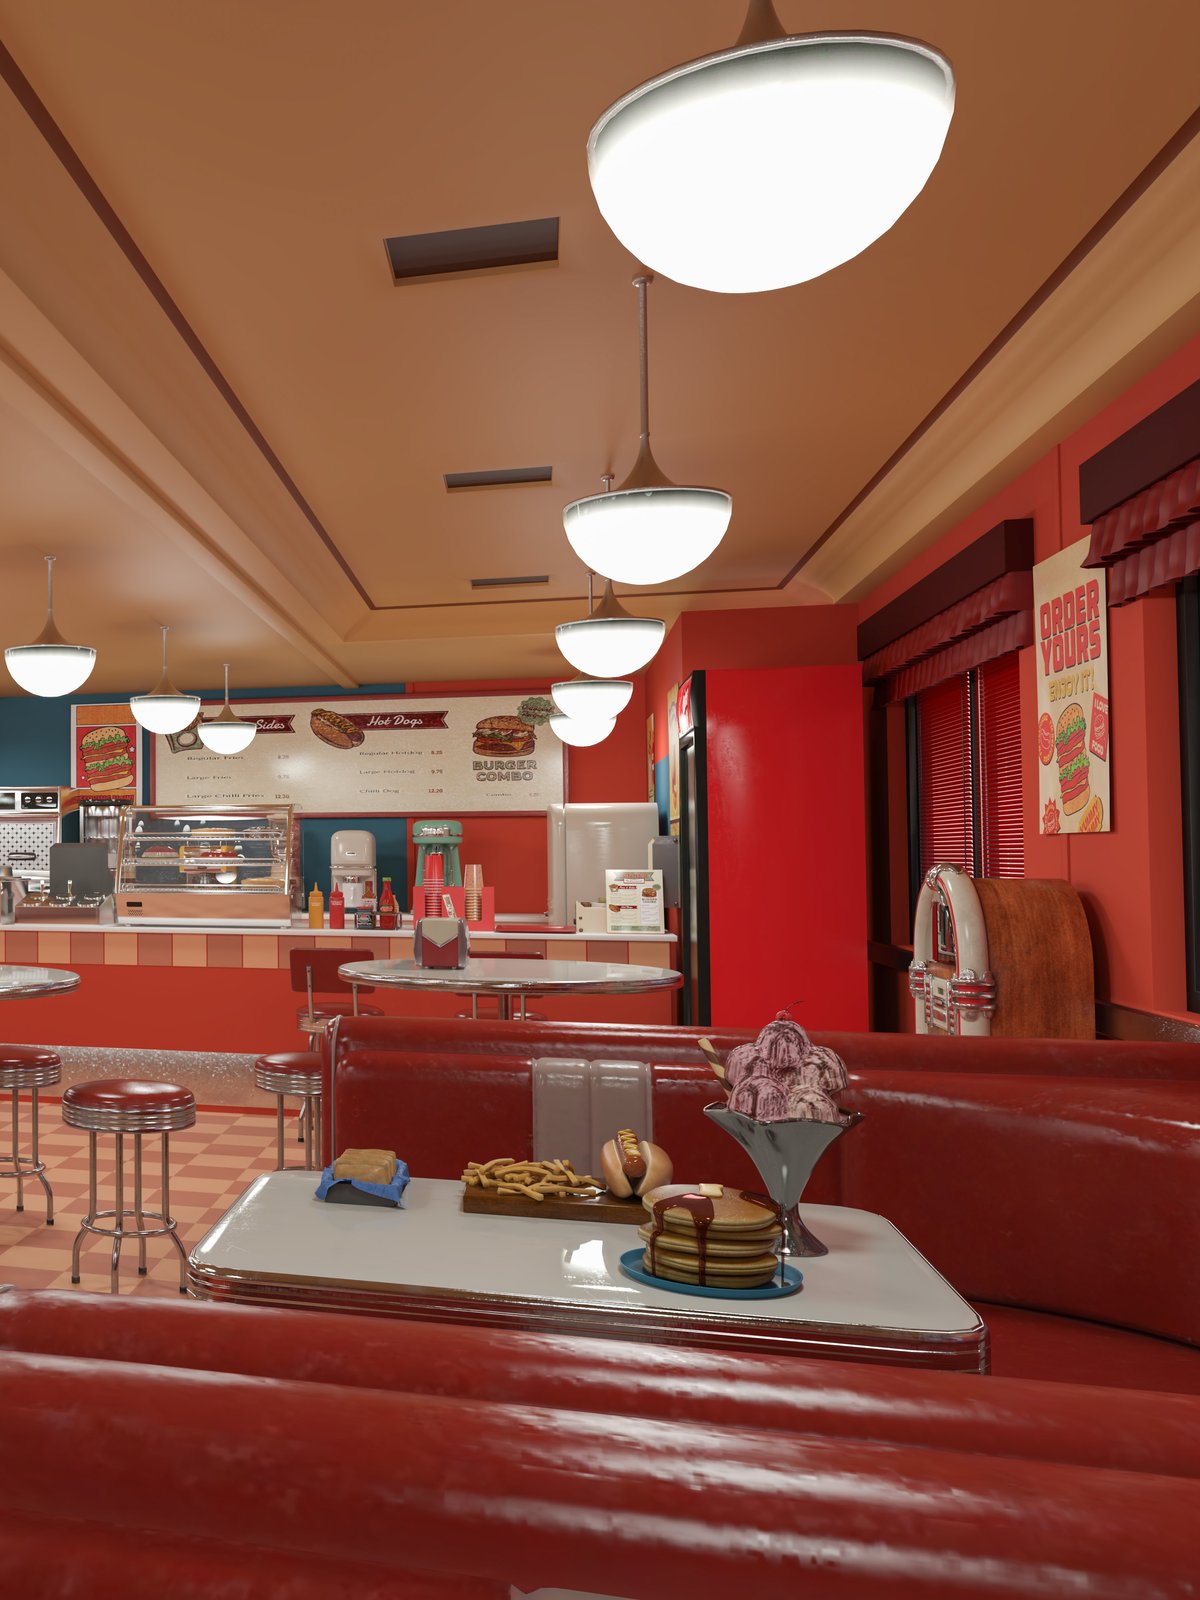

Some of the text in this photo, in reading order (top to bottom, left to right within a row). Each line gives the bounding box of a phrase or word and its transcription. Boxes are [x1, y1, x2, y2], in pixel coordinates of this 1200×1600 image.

[1040, 579, 1099, 640] ORDER
[1040, 620, 1101, 676] YOURS
[1048, 667, 1095, 702] ENJOY IT!
[256, 718, 285, 731] Sides
[366, 714, 423, 728] Hot Dogs
[472, 760, 538, 771] BURGER
[476, 771, 534, 782] COMBO
